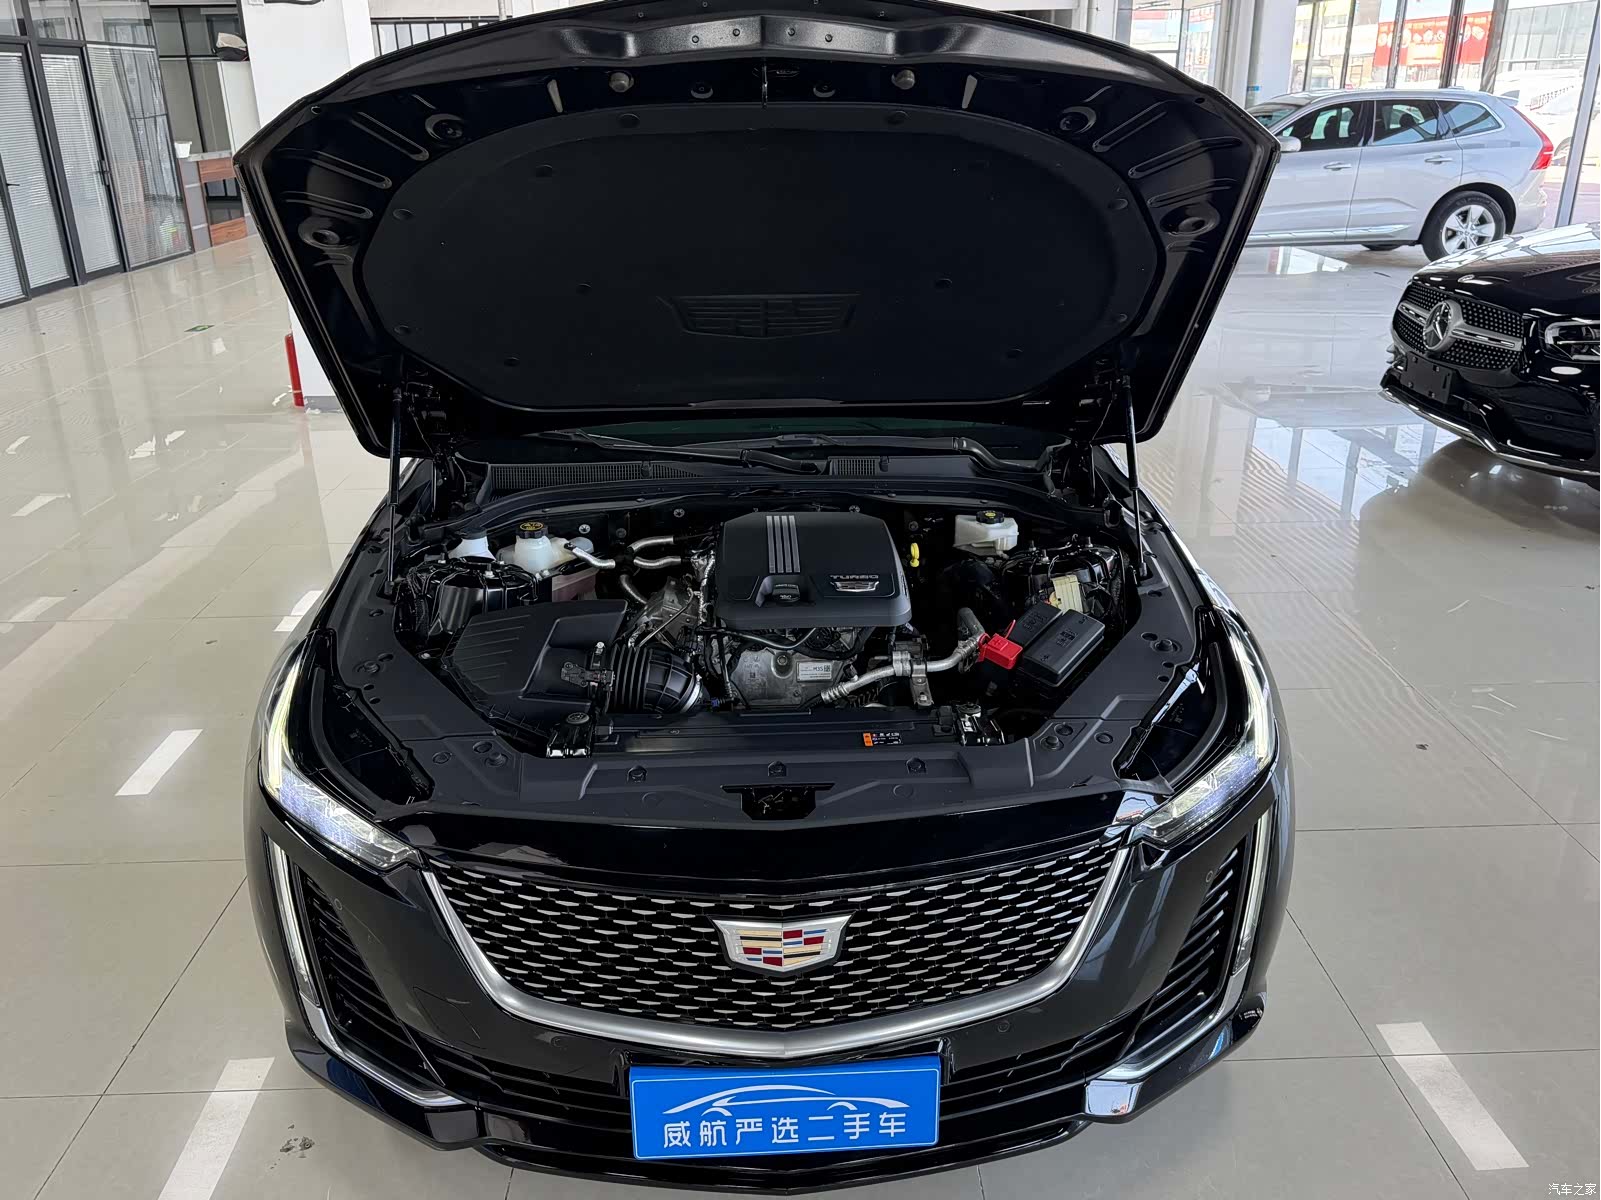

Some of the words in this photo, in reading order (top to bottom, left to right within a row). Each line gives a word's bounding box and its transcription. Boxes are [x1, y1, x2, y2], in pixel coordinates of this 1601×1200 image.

[663, 1112, 907, 1149] 威航严选二手车
